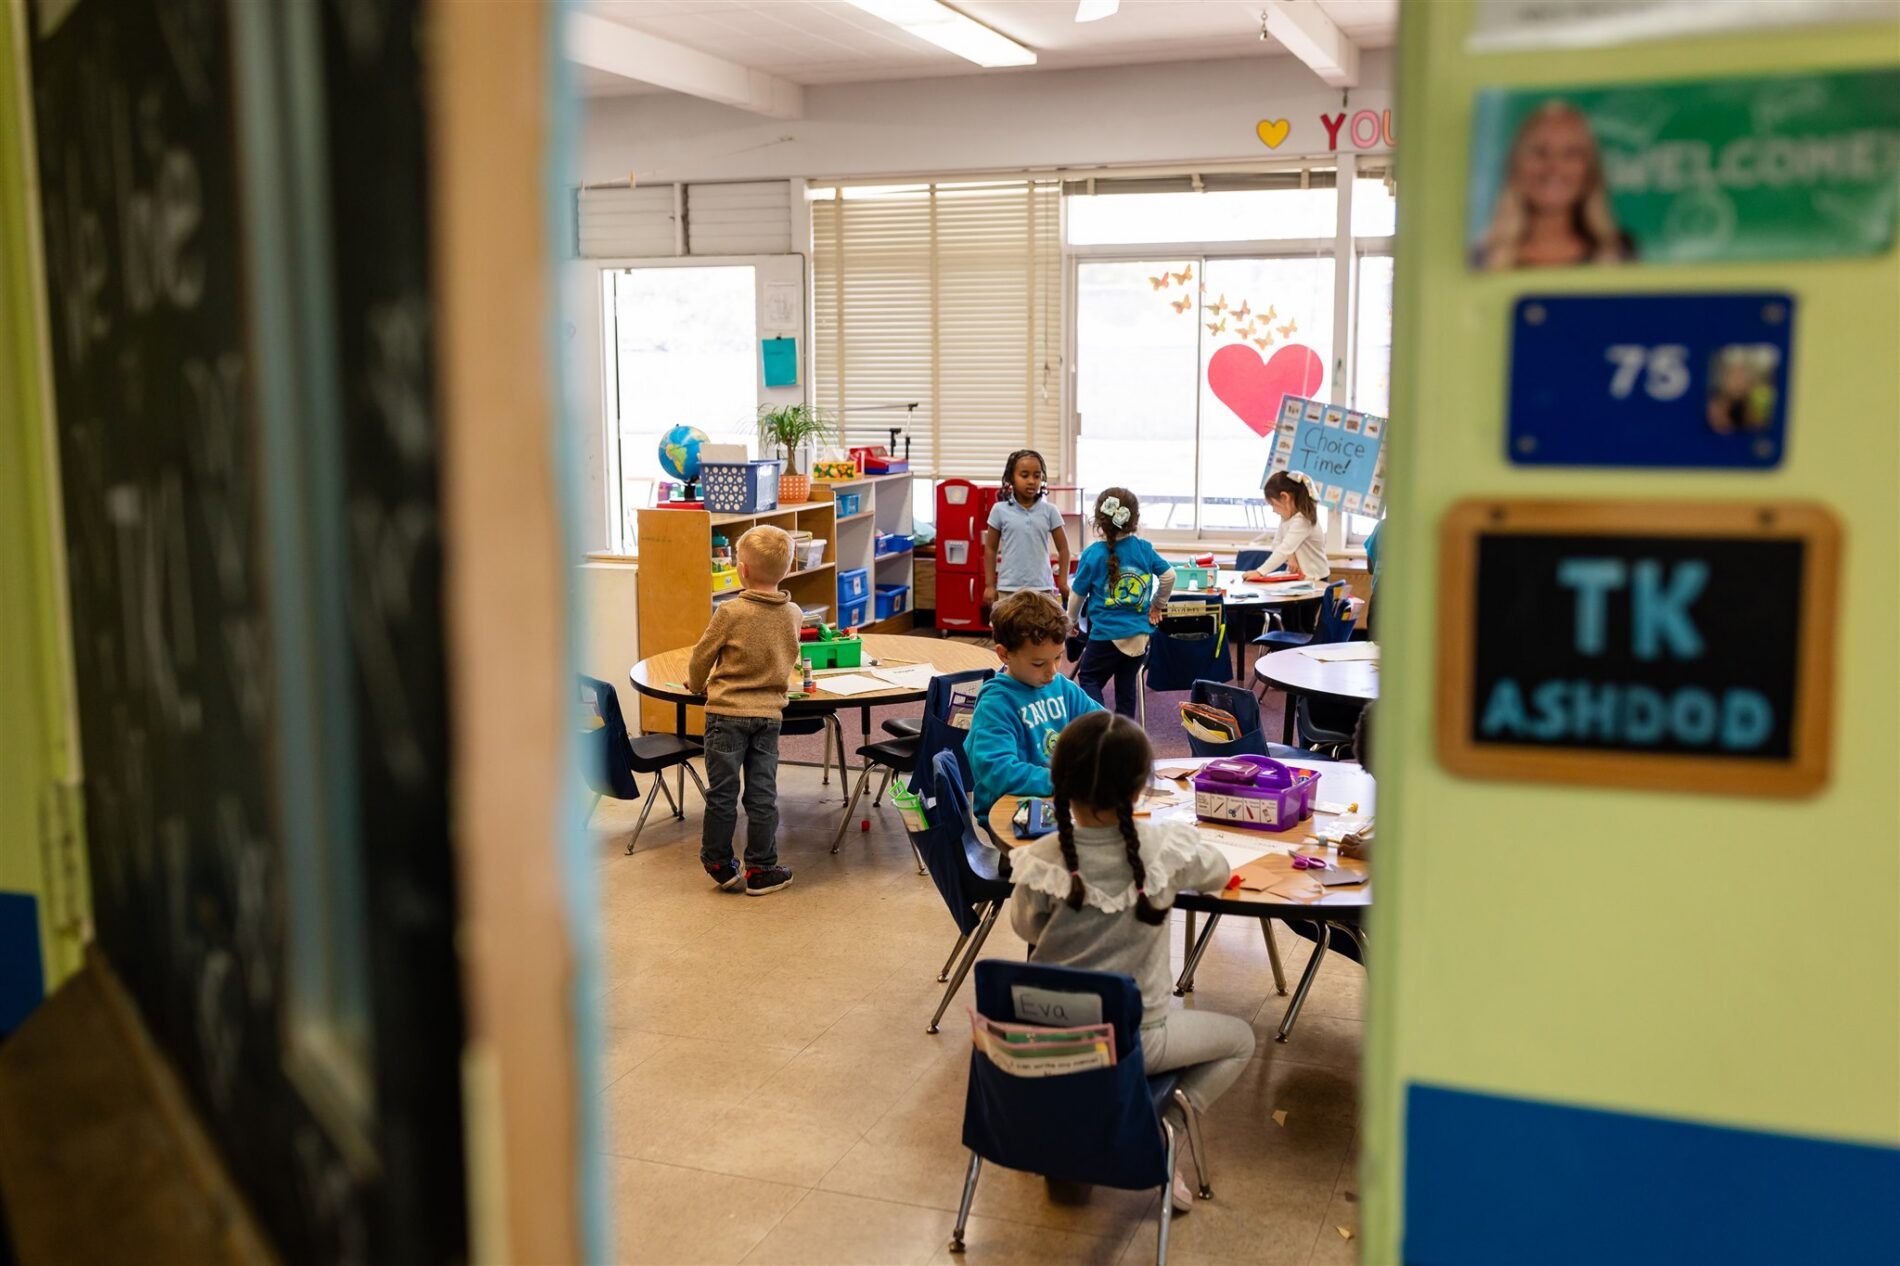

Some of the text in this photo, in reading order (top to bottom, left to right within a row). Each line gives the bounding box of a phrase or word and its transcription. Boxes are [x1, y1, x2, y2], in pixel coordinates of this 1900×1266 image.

[1606, 344, 1691, 400] 75
[1301, 448, 1352, 475] Time!
[1303, 426, 1365, 458] Choice
[1557, 556, 1709, 660] TK
[1481, 677, 1775, 750] ASHDOD
[1020, 993, 1069, 1021] Eva
